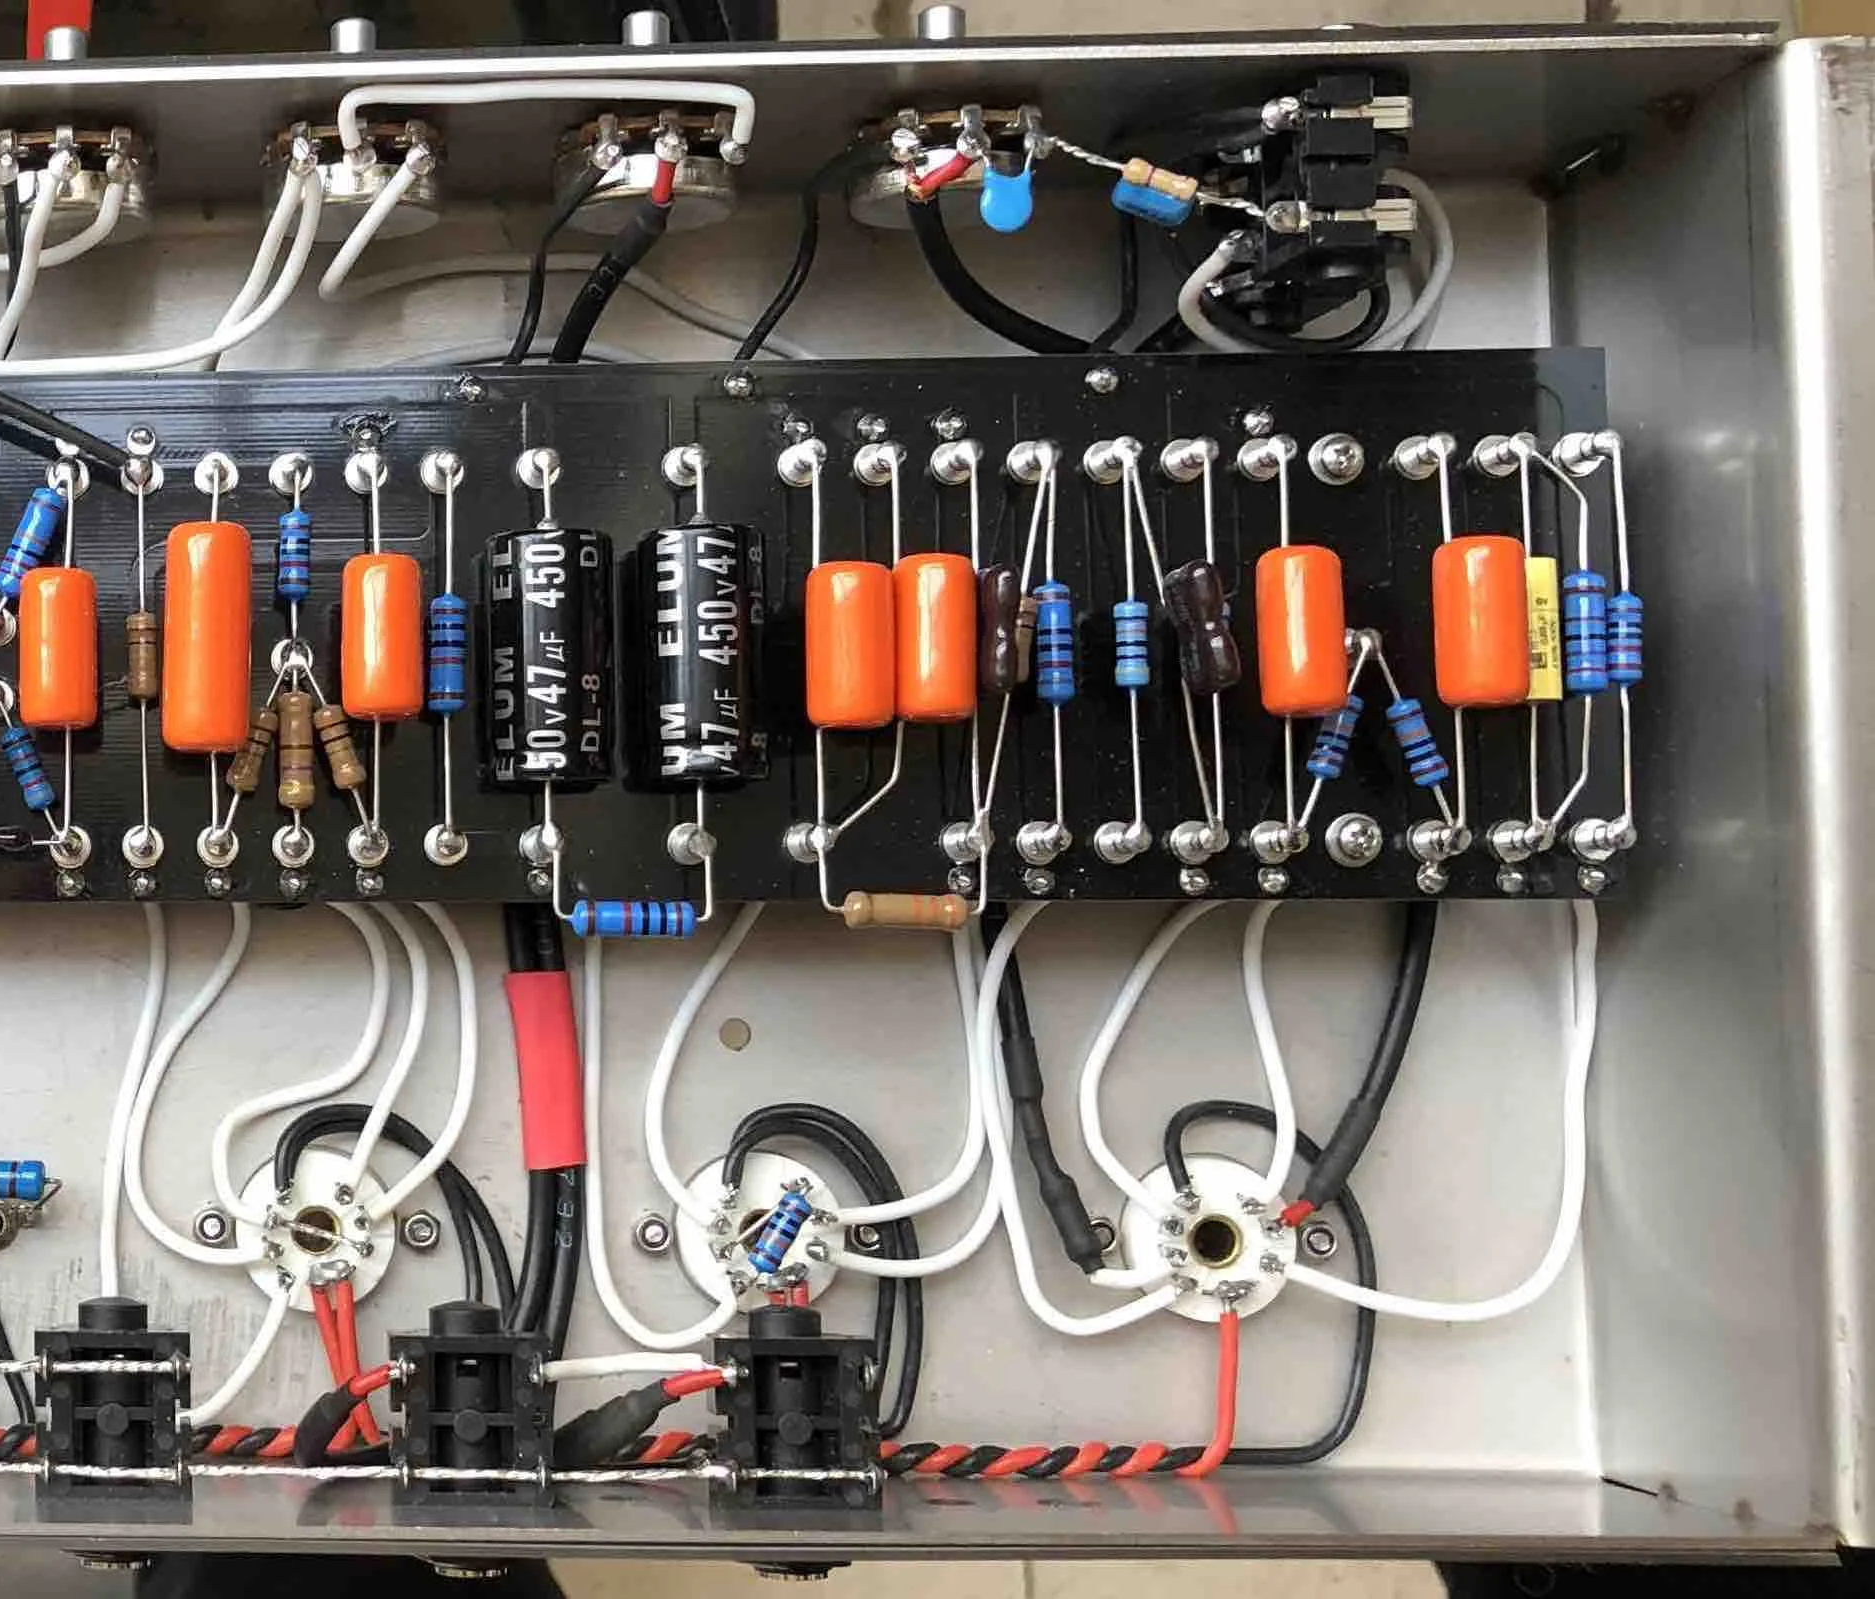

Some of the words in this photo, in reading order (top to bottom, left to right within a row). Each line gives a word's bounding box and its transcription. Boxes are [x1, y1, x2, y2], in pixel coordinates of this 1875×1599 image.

[657, 530, 685, 658] ELUM
[494, 646, 516, 782] ELUM
[580, 673, 602, 753] DL-8
